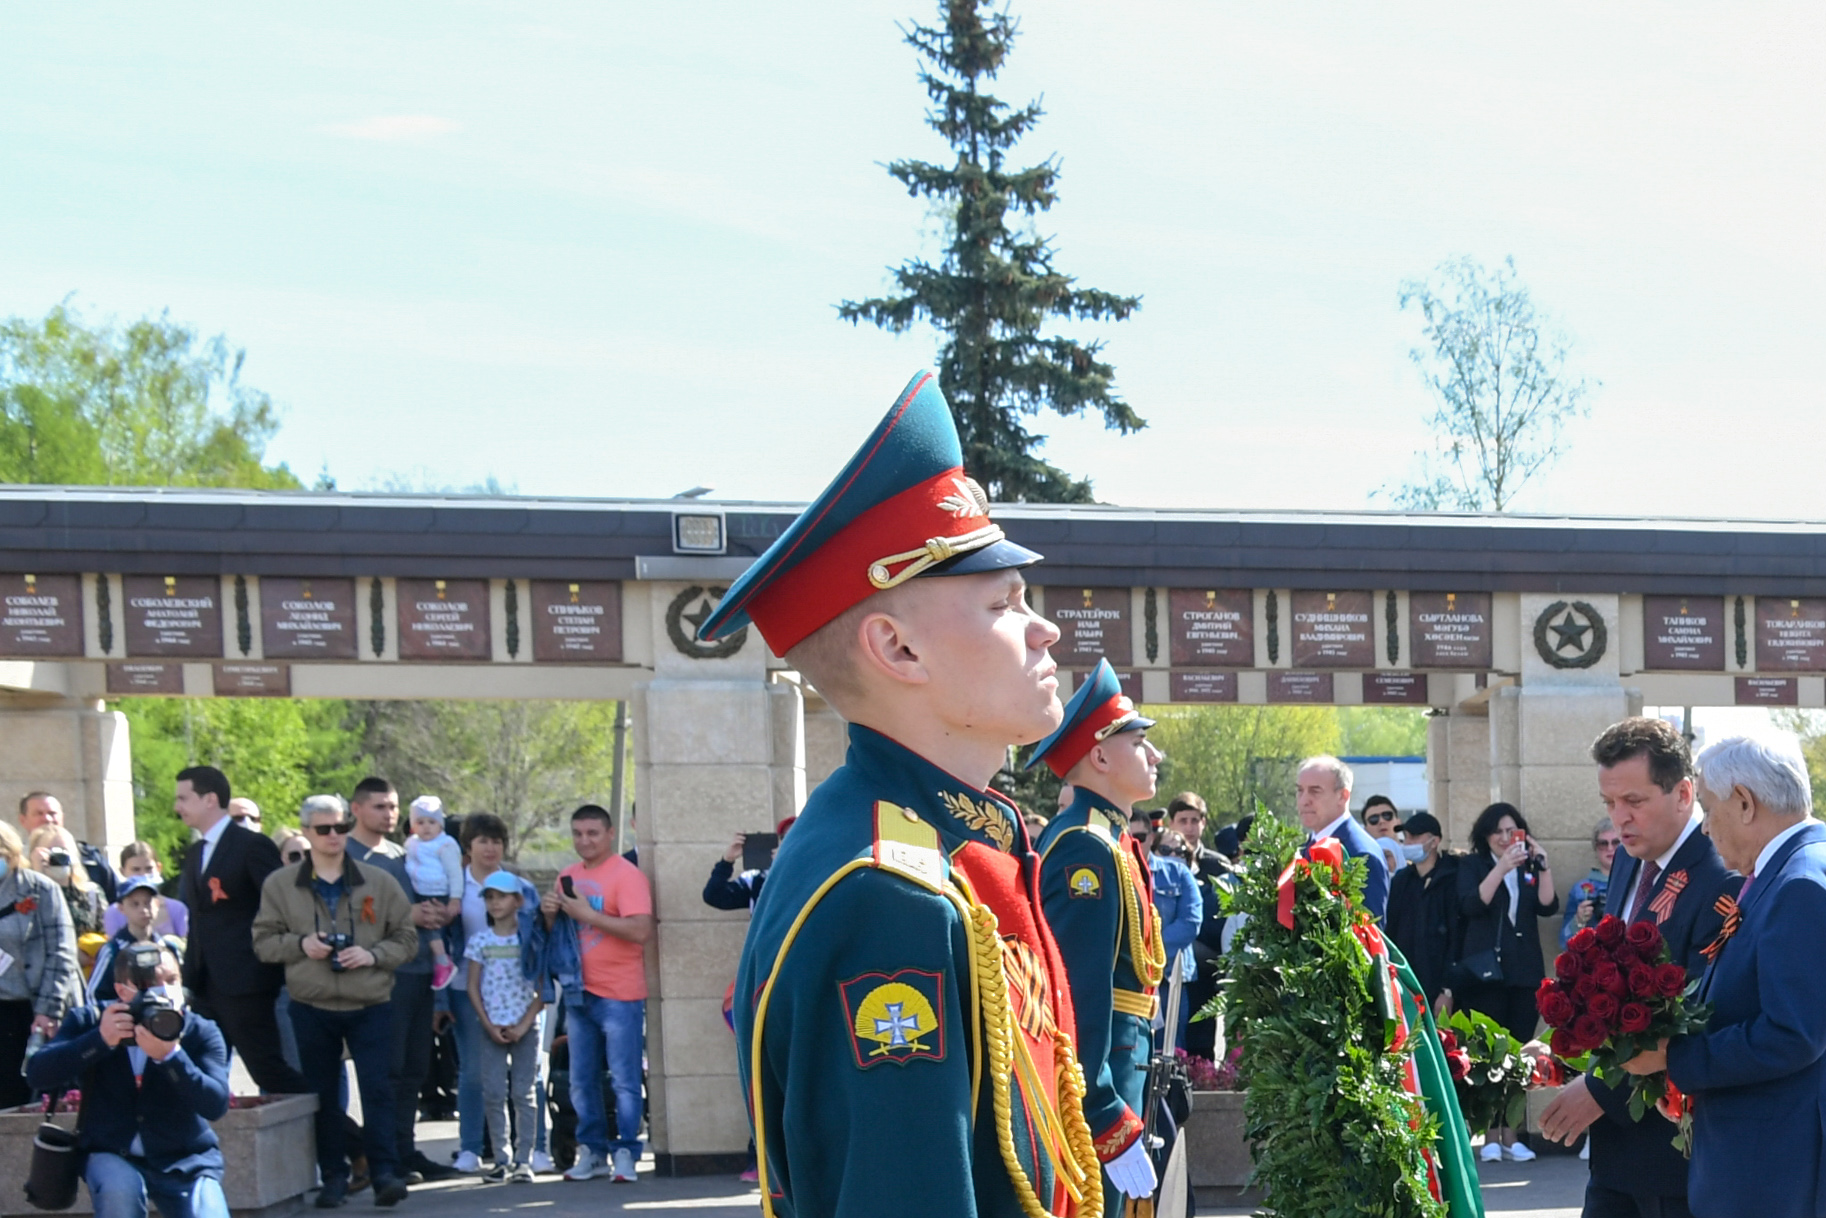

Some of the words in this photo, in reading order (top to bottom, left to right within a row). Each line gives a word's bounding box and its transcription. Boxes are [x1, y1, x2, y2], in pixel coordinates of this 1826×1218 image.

[131, 598, 212, 609] СОБОЛЕВСКИЙ
[1057, 610, 1120, 619] СТРАТЕЙЧУК
[1183, 612, 1240, 621] СТРОГАНОВ
[1419, 614, 1484, 623] СЫРТЛАНОВА
[1192, 620, 1232, 631] ДМИТРИЙ
